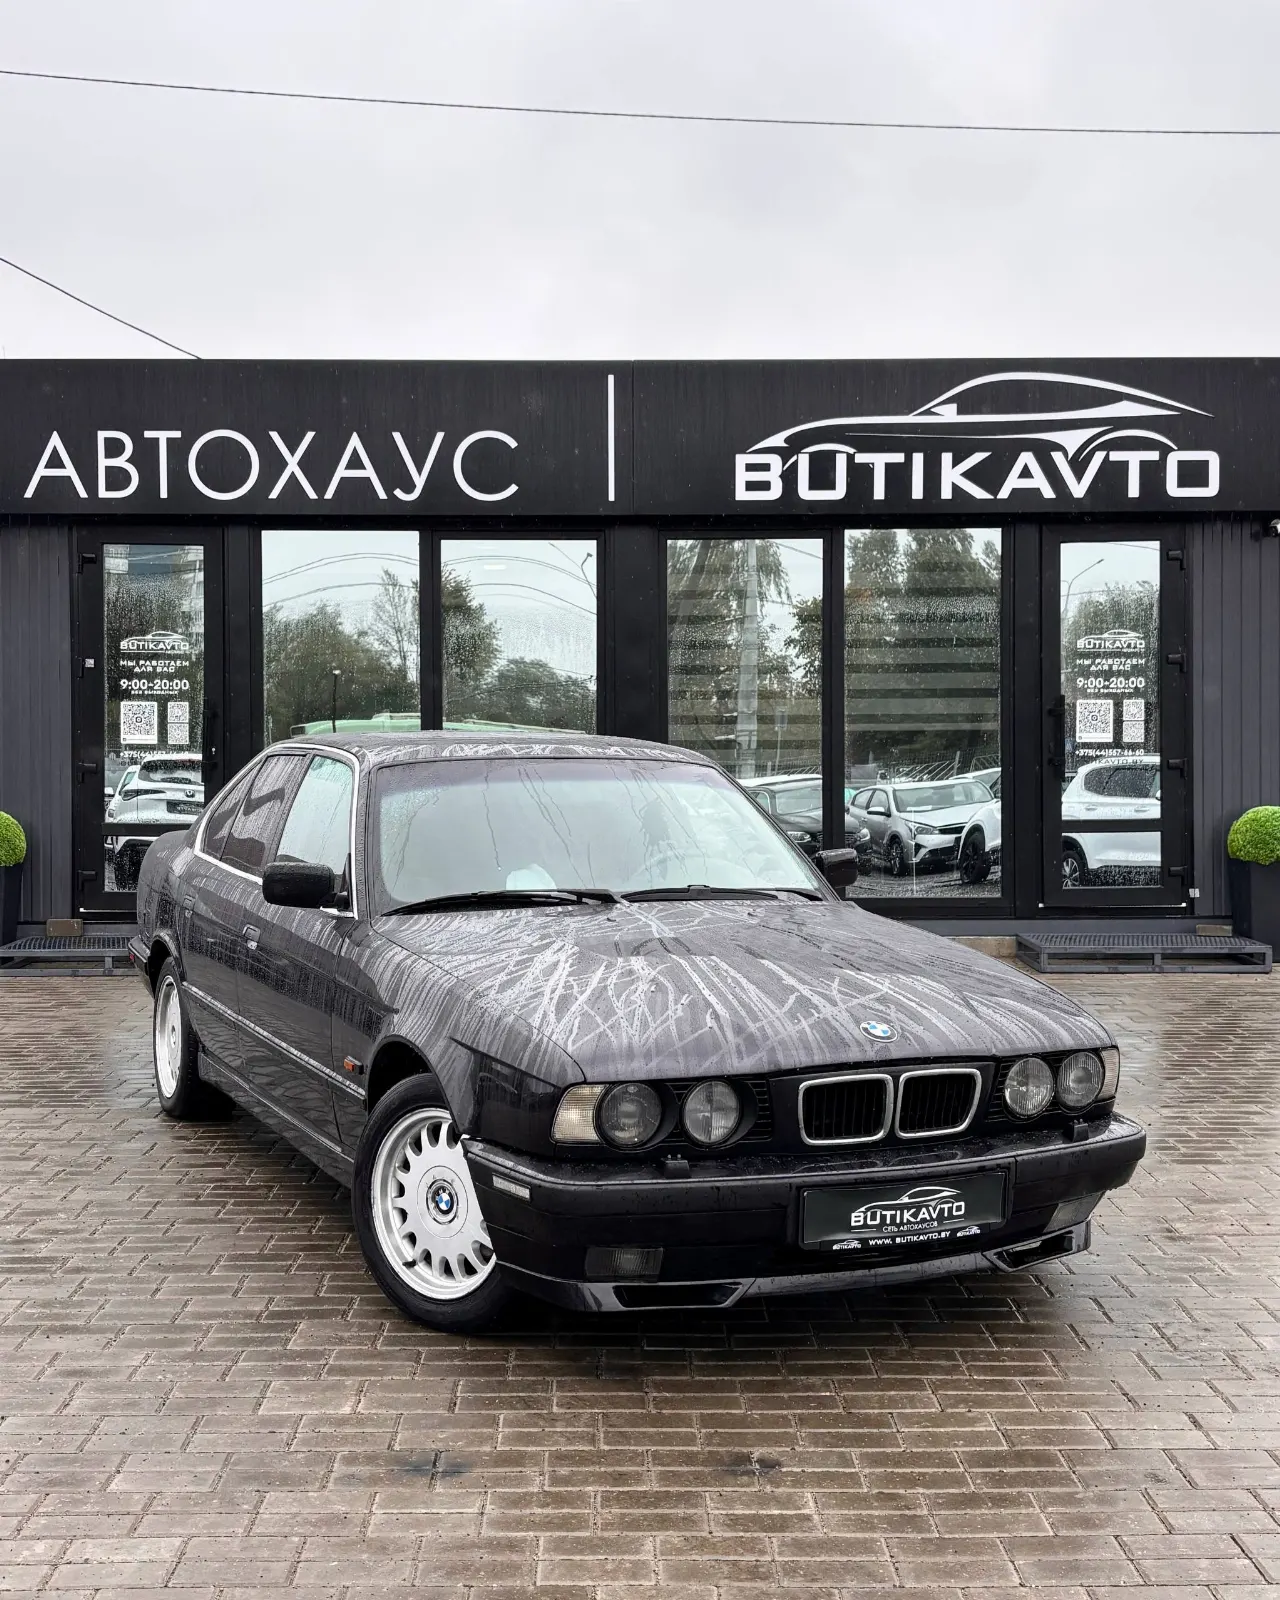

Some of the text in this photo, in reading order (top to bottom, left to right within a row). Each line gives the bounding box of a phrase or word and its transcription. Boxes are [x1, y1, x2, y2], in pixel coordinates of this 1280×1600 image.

[23, 429, 519, 502] АВТОХАУС
[734, 449, 1220, 501] BUTIKAVTO
[120, 641, 189, 650] BUTIKAVTO
[1076, 639, 1145, 649] BUTIKAVTO
[120, 679, 189, 690] 9:00-20:00
[1076, 677, 1145, 688] 9:00-20:00
[850, 1201, 966, 1227] BUTIKAVTO
[882, 1220, 938, 1233] СЕТЬ АВТОХАУСОВ
[868, 1231, 951, 1246] WWW. BUTIKAVTO.BY
